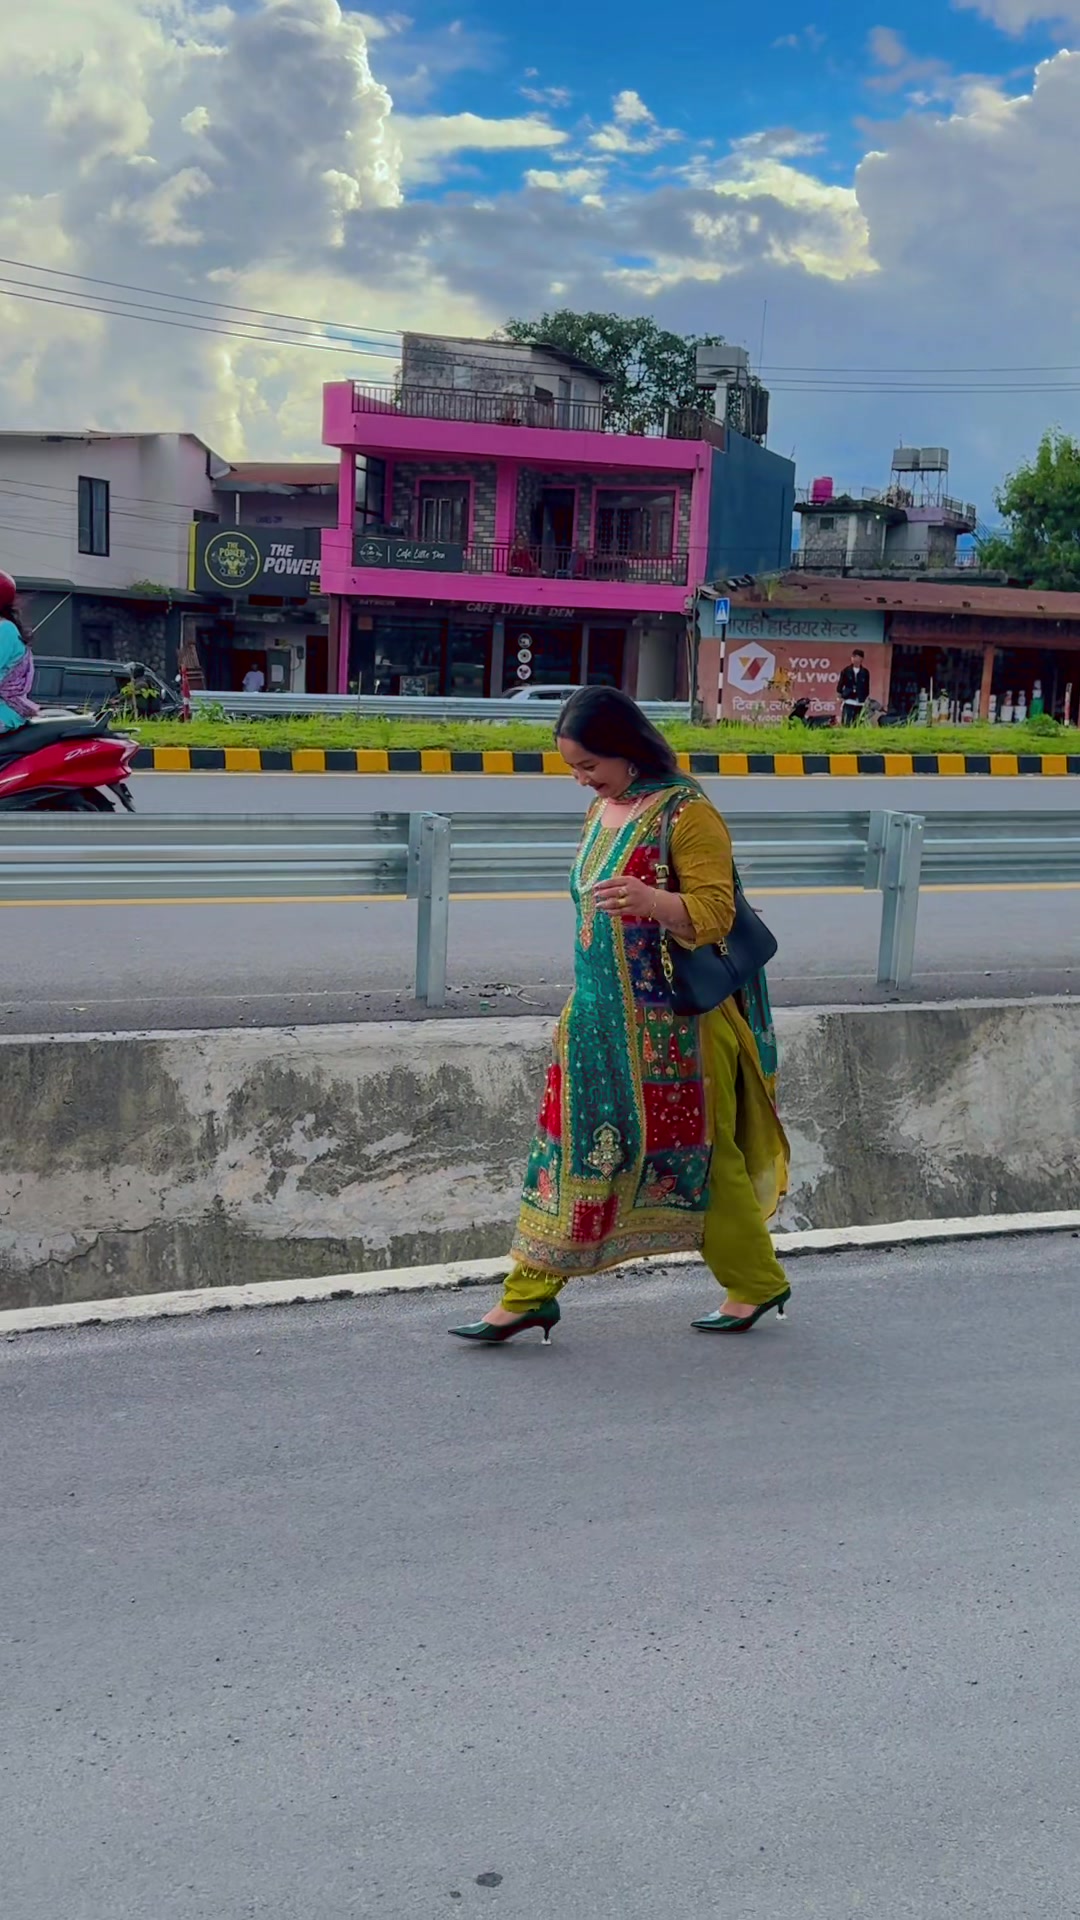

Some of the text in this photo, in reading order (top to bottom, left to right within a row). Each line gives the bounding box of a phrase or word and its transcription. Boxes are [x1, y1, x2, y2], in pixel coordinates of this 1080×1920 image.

[219, 547, 246, 558] POWER
[270, 543, 294, 557] THE
[263, 557, 321, 576] POWER
[466, 602, 575, 618] CAFE LITTLE DEN
[788, 657, 831, 669] YOYO
[64, 744, 101, 760] Duet
